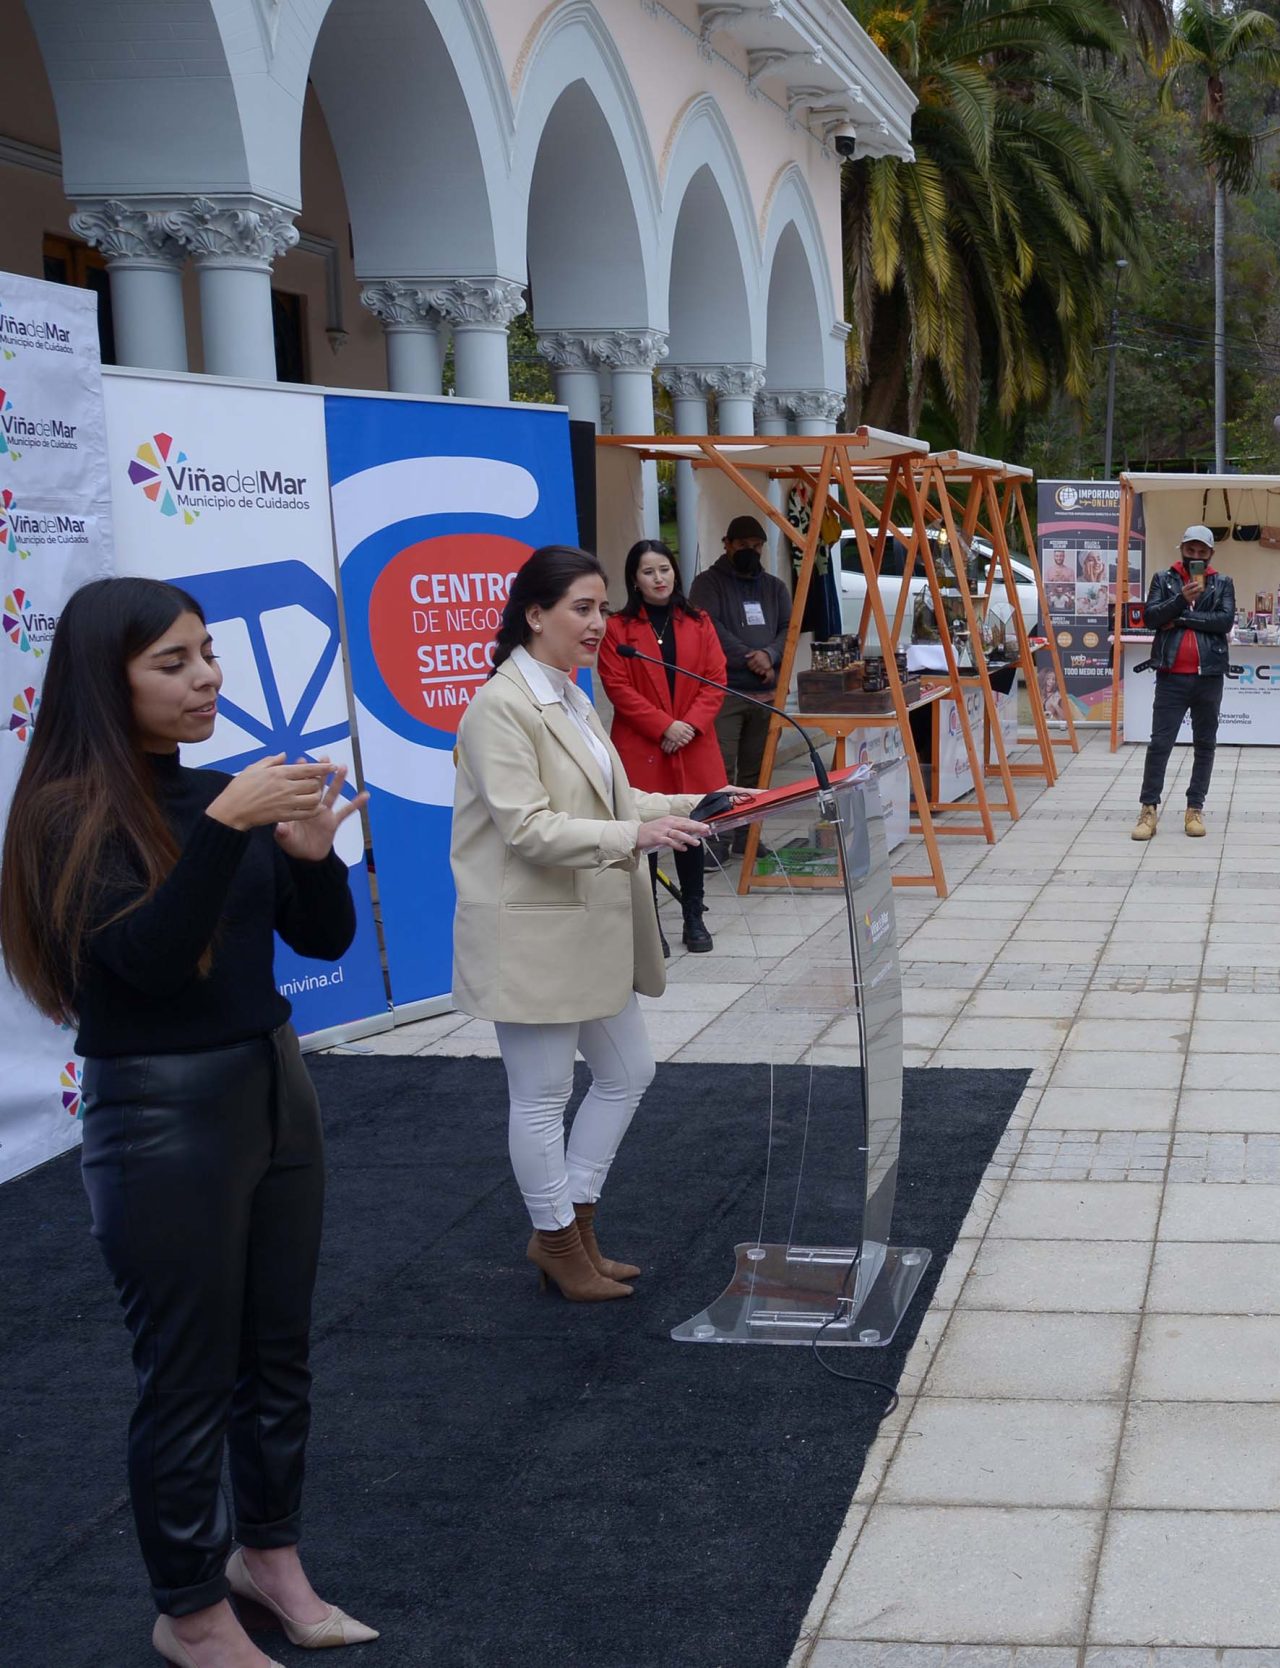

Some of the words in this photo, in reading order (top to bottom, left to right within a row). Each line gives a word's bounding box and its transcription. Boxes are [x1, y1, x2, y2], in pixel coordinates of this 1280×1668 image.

[177, 494, 236, 511] Municipio
[238, 496, 253, 508] de
[255, 497, 310, 510] Cuidados
[1079, 489, 1121, 500] IMPORTADO
[46, 535, 56, 544] de
[58, 535, 89, 544] Cuidados
[413, 609, 441, 634] DE
[446, 607, 503, 632] NEGO
[422, 684, 470, 708] VIÑA
